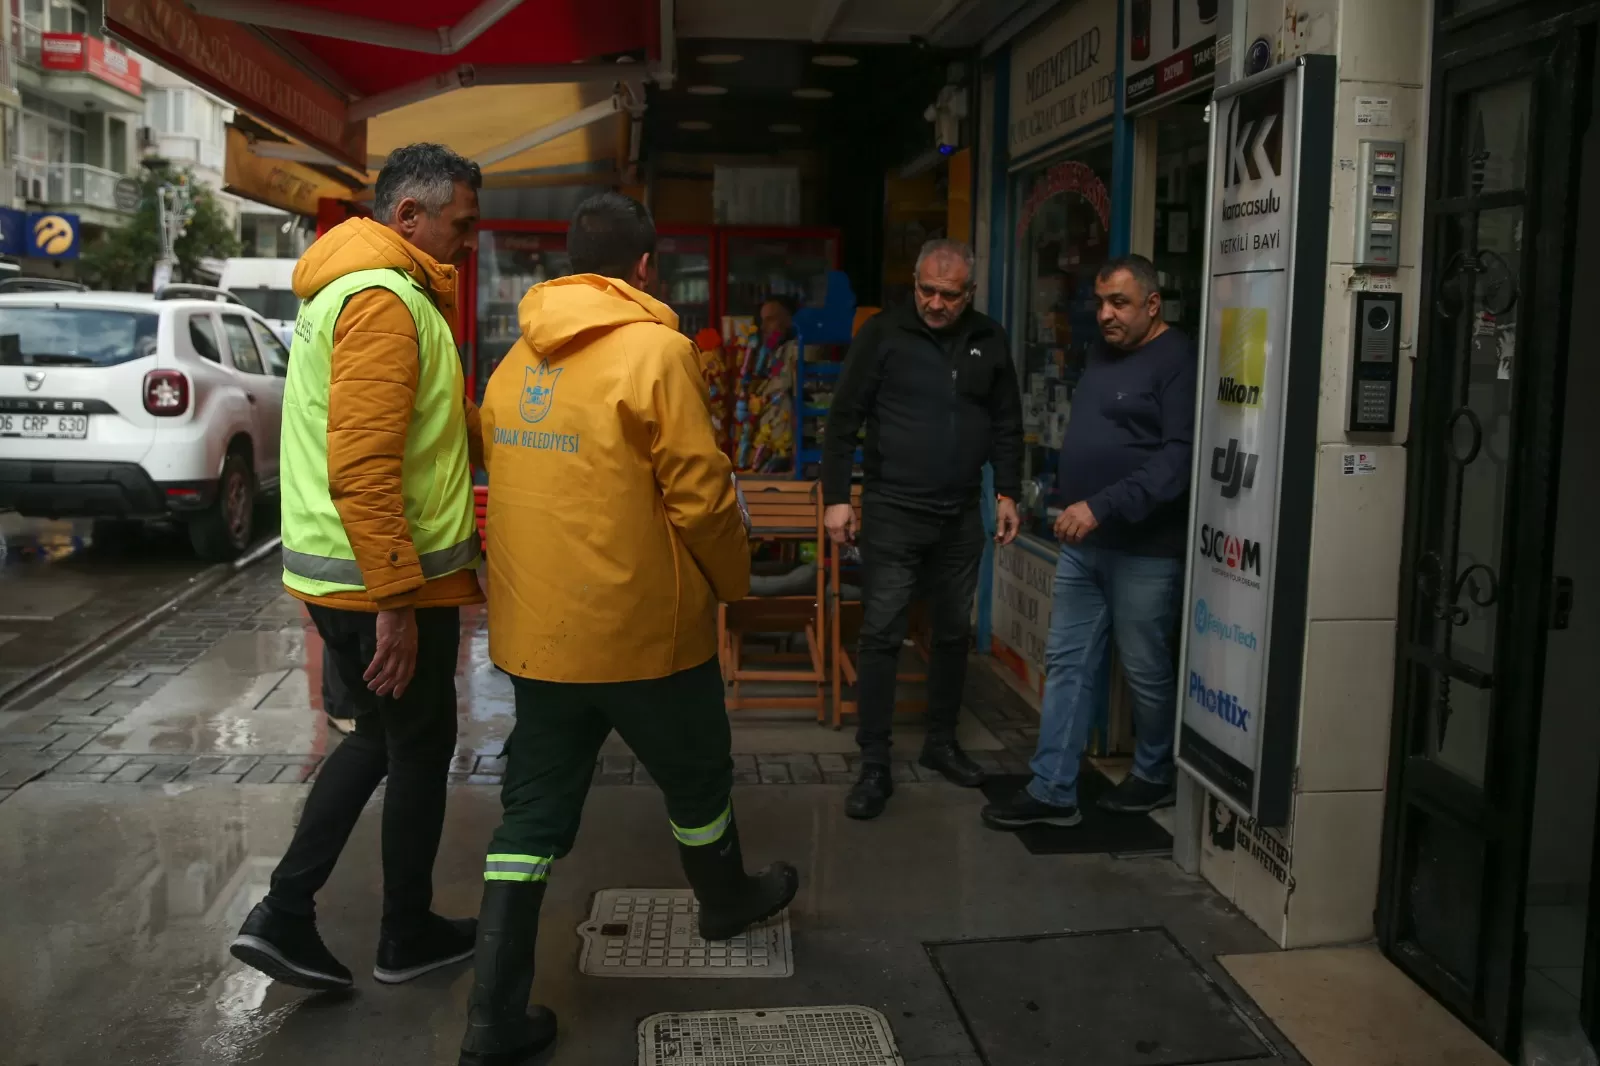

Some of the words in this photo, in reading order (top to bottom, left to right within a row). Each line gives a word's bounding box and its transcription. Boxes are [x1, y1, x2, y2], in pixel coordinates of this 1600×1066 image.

[1026, 26, 1100, 105] MEHMETLER
[1222, 188, 1281, 222] karacasulu
[1220, 233, 1248, 255] YETKİLİ
[1253, 229, 1280, 250] BAYİ
[1217, 377, 1259, 405] Nikon
[22, 415, 48, 431] CRP
[58, 416, 85, 432] 630
[493, 427, 520, 446] ONAK
[522, 431, 580, 453] BELEDİYESİ
[1200, 523, 1261, 577] SJCAM
[1189, 669, 1248, 732] Phottix
[746, 1041, 791, 1053] GAZ
